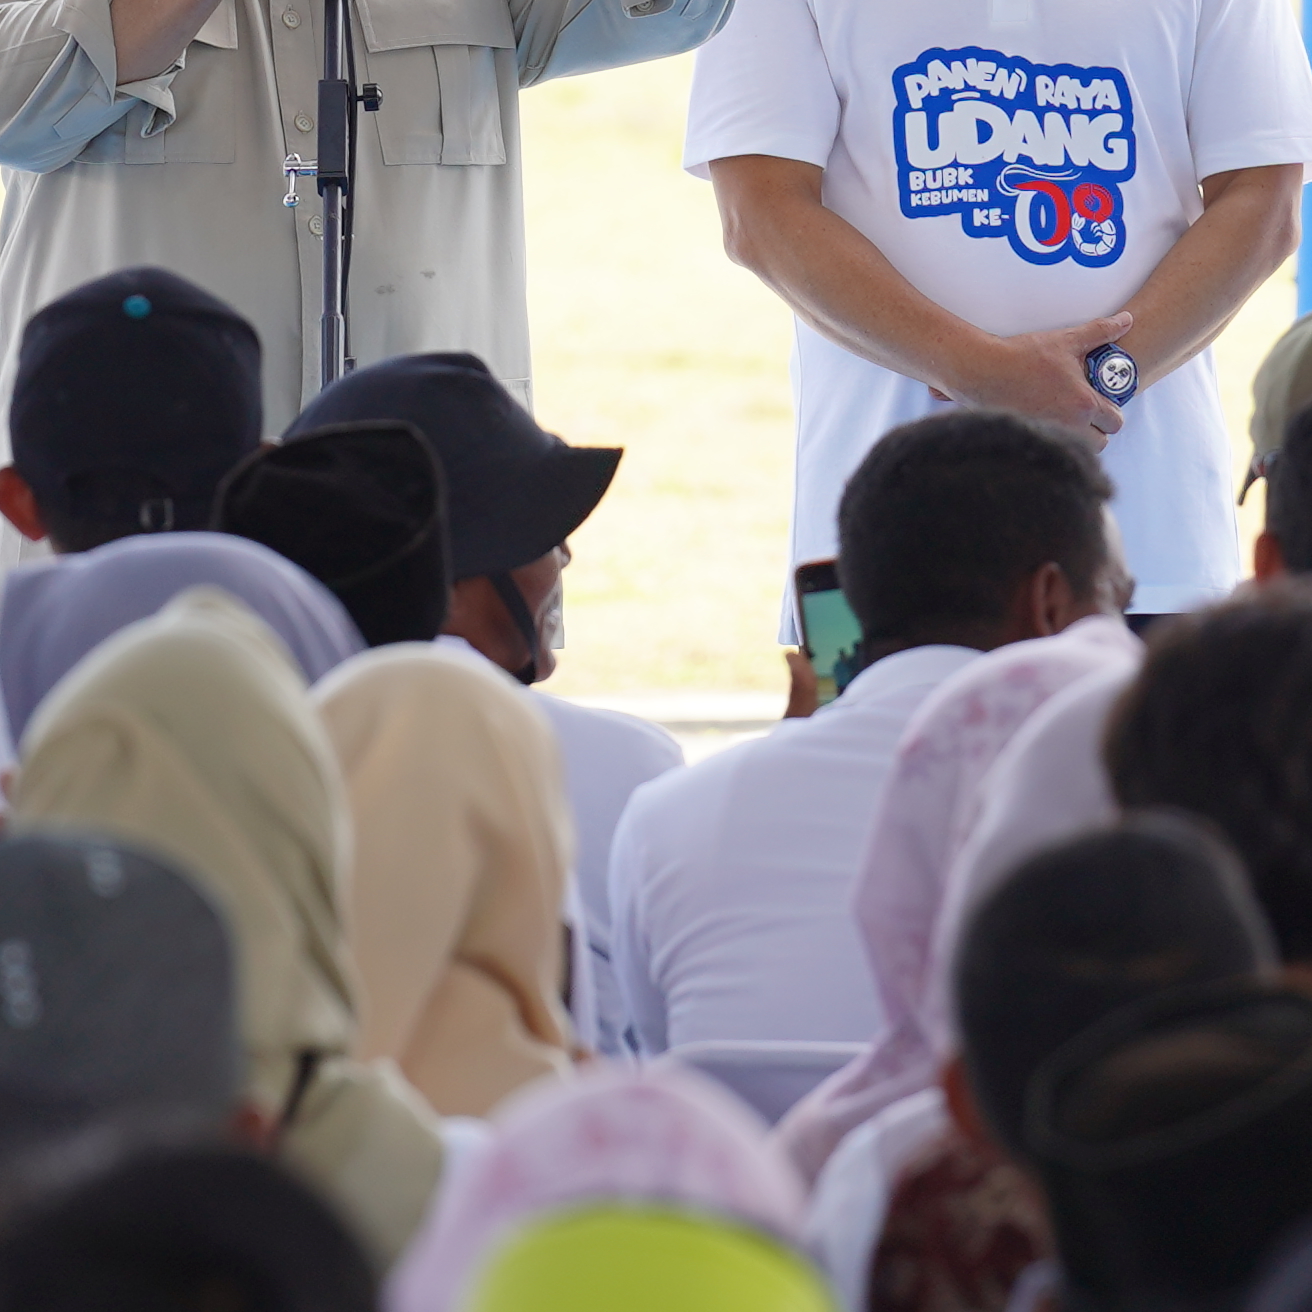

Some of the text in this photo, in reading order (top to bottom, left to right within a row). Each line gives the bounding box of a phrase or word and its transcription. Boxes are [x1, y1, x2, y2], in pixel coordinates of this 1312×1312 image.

[904, 57, 1121, 110] PANEN RAYA
[904, 99, 1129, 171] UDANG
[908, 167, 974, 191] BUBK
[910, 188, 989, 207] KEBUMEN
